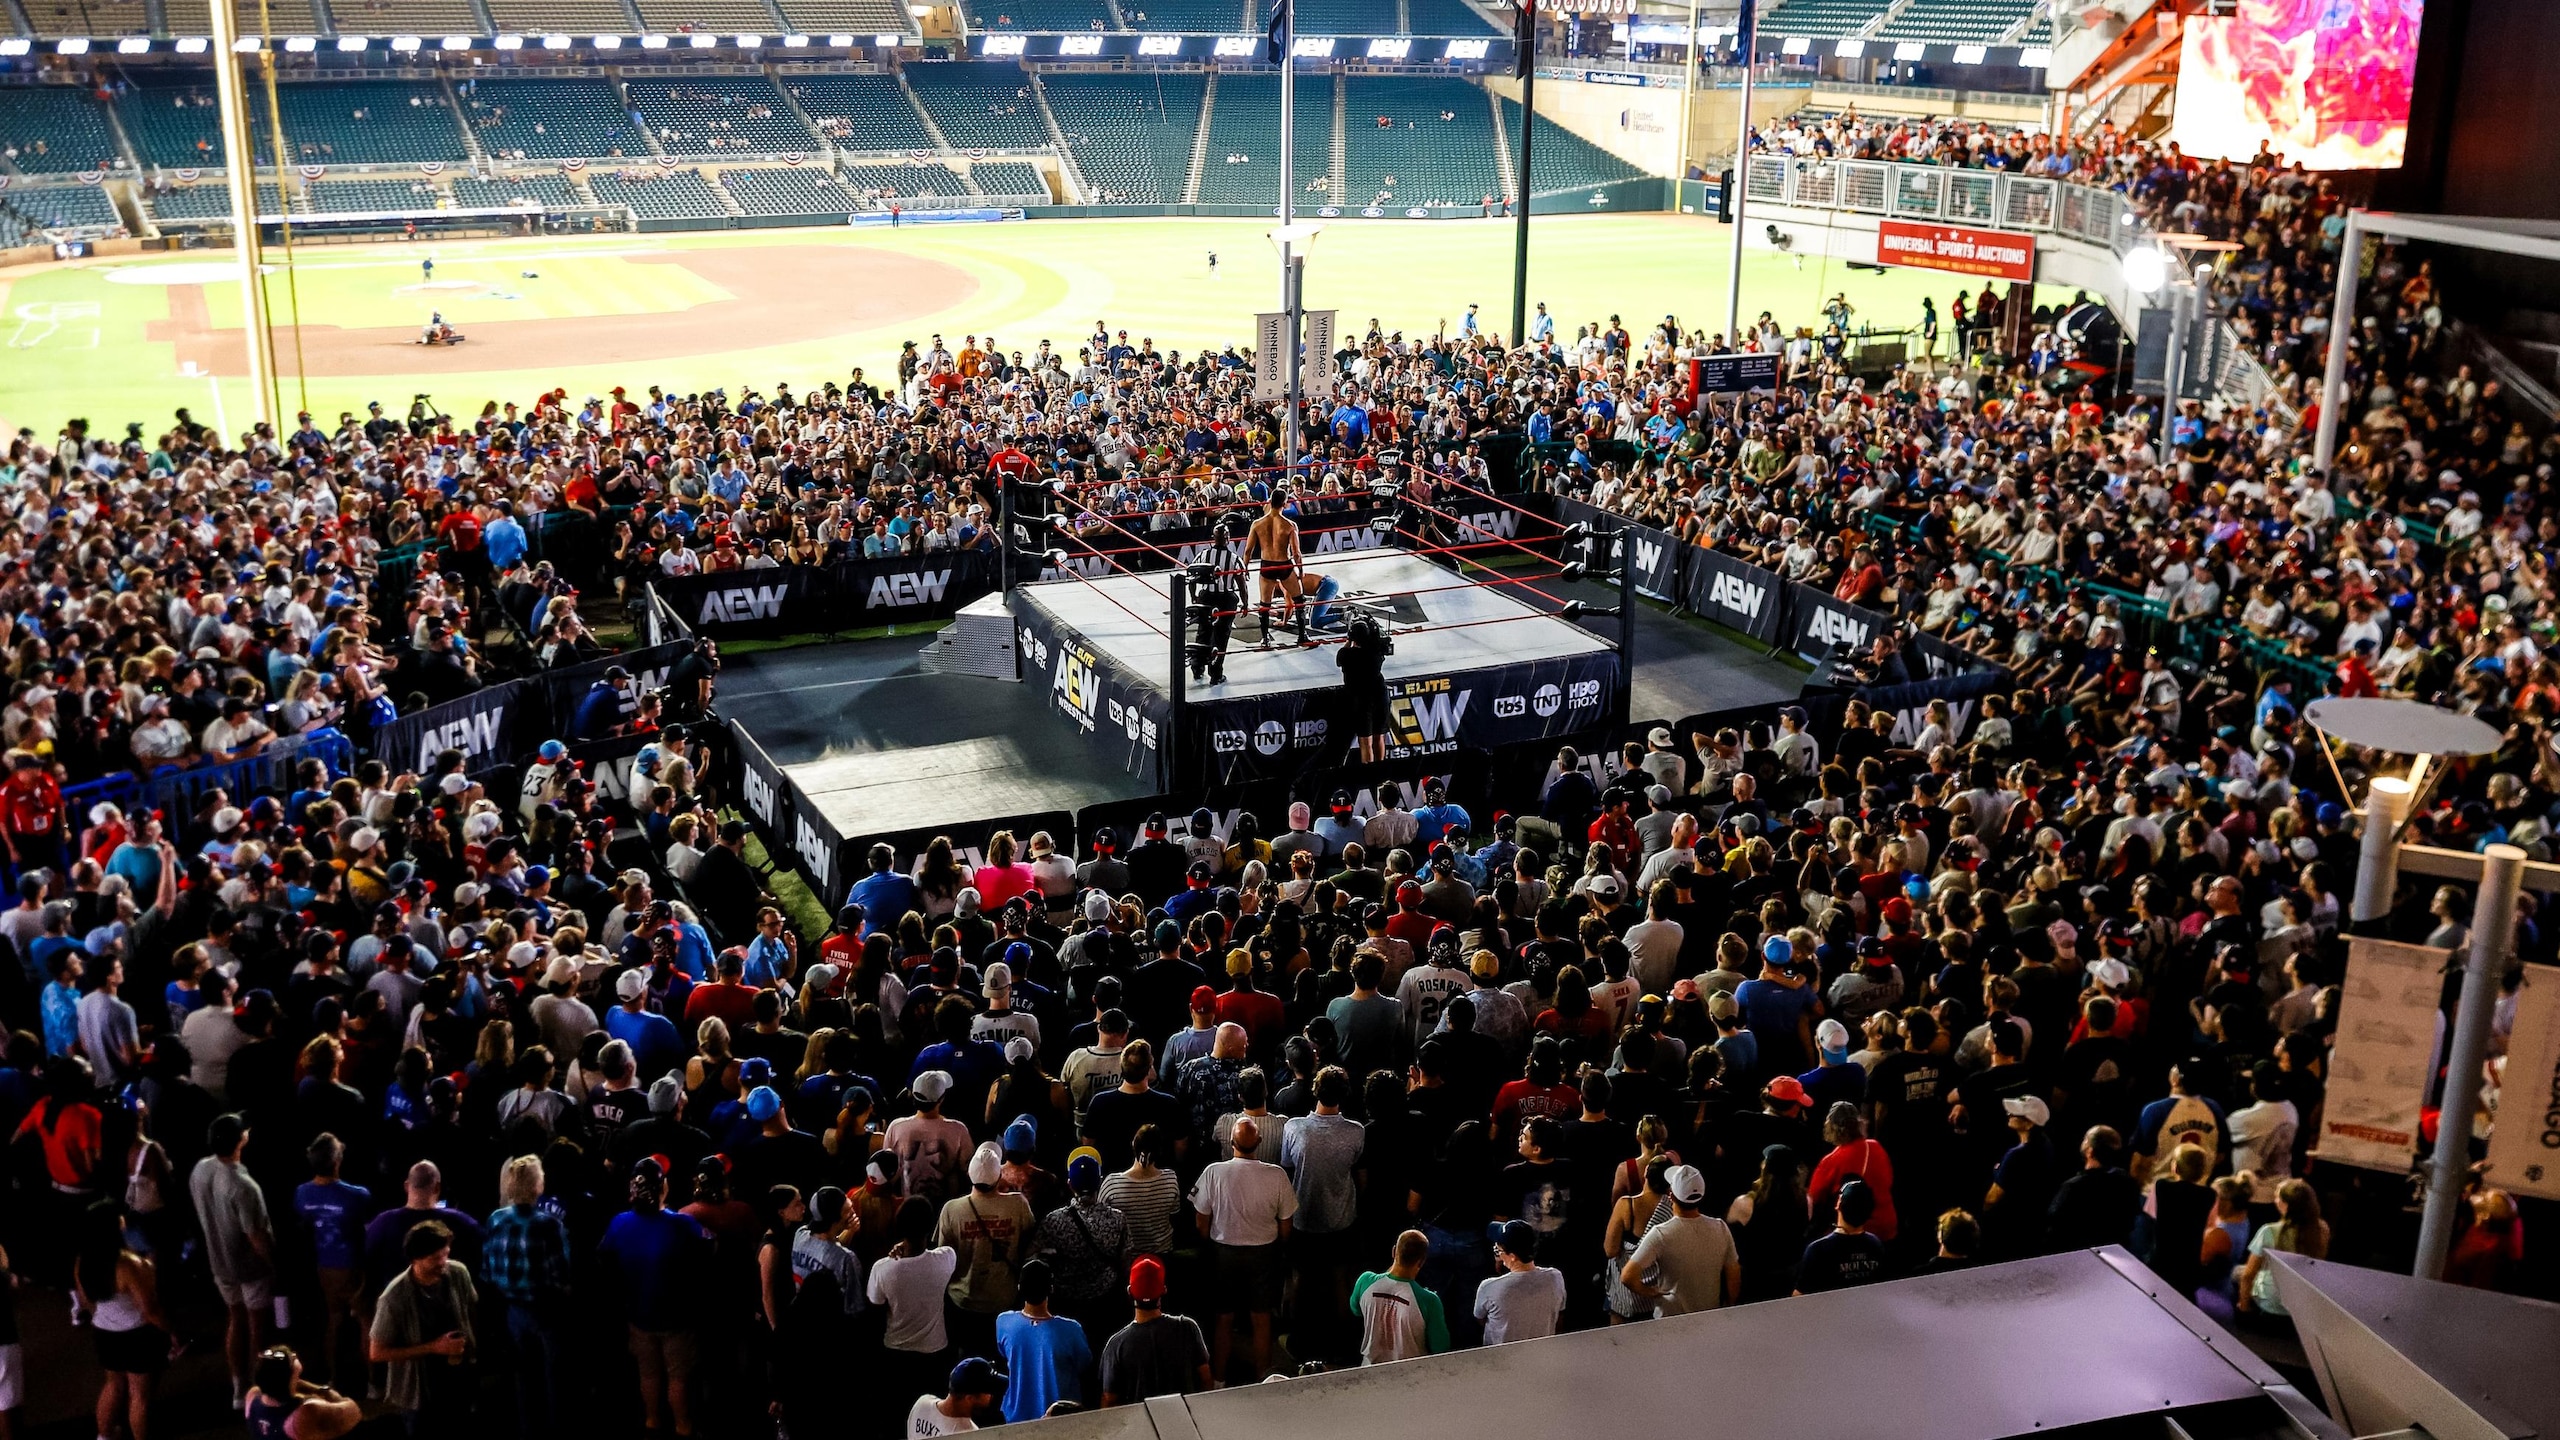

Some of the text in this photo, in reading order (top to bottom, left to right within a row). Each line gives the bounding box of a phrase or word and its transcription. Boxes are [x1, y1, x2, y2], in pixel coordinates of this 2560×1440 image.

[1633, 110, 1653, 121] United
[1884, 234, 1935, 254] UNIVERSAL
[1936, 239, 1975, 259] SPORTS
[1975, 245, 2026, 265] AUCTIONS
[1270, 319, 1278, 381] WINNEBAGO
[1318, 317, 1328, 378] WINNEBAGO
[1378, 455, 1399, 465] AEW
[1374, 487, 1398, 497] AEW
[1372, 521, 1393, 531] AEW
[1456, 510, 1522, 544] AEW
[1611, 536, 1662, 575] AW
[866, 569, 951, 609] AEW
[1709, 571, 1766, 618] AEW
[699, 584, 788, 624] AEW
[1808, 605, 1869, 648] AEW
[1063, 639, 1097, 668] ALL ELITE
[1053, 649, 1101, 718] AEW
[1406, 678, 1451, 694] ELITE
[1569, 679, 1600, 699] HBO
[1496, 697, 1525, 715] tbs
[1533, 692, 1562, 709] TNT
[1568, 695, 1599, 709] max
[1057, 697, 1095, 732] WRESTLING
[1368, 689, 1472, 747] EW
[1294, 719, 1328, 738] HBO
[420, 707, 503, 774] AEW
[1215, 731, 1246, 750] tbs
[1294, 735, 1326, 751] max
[522, 775, 546, 796] 23
[744, 763, 774, 827] AEW
[796, 813, 830, 887] AEW
[825, 956, 854, 969] SECURITY
[830, 949, 849, 961] EVENT
[1009, 997, 1032, 1010] PLER
[1084, 1071, 1123, 1090] Twin
[916, 1418, 940, 1437] BUXT
